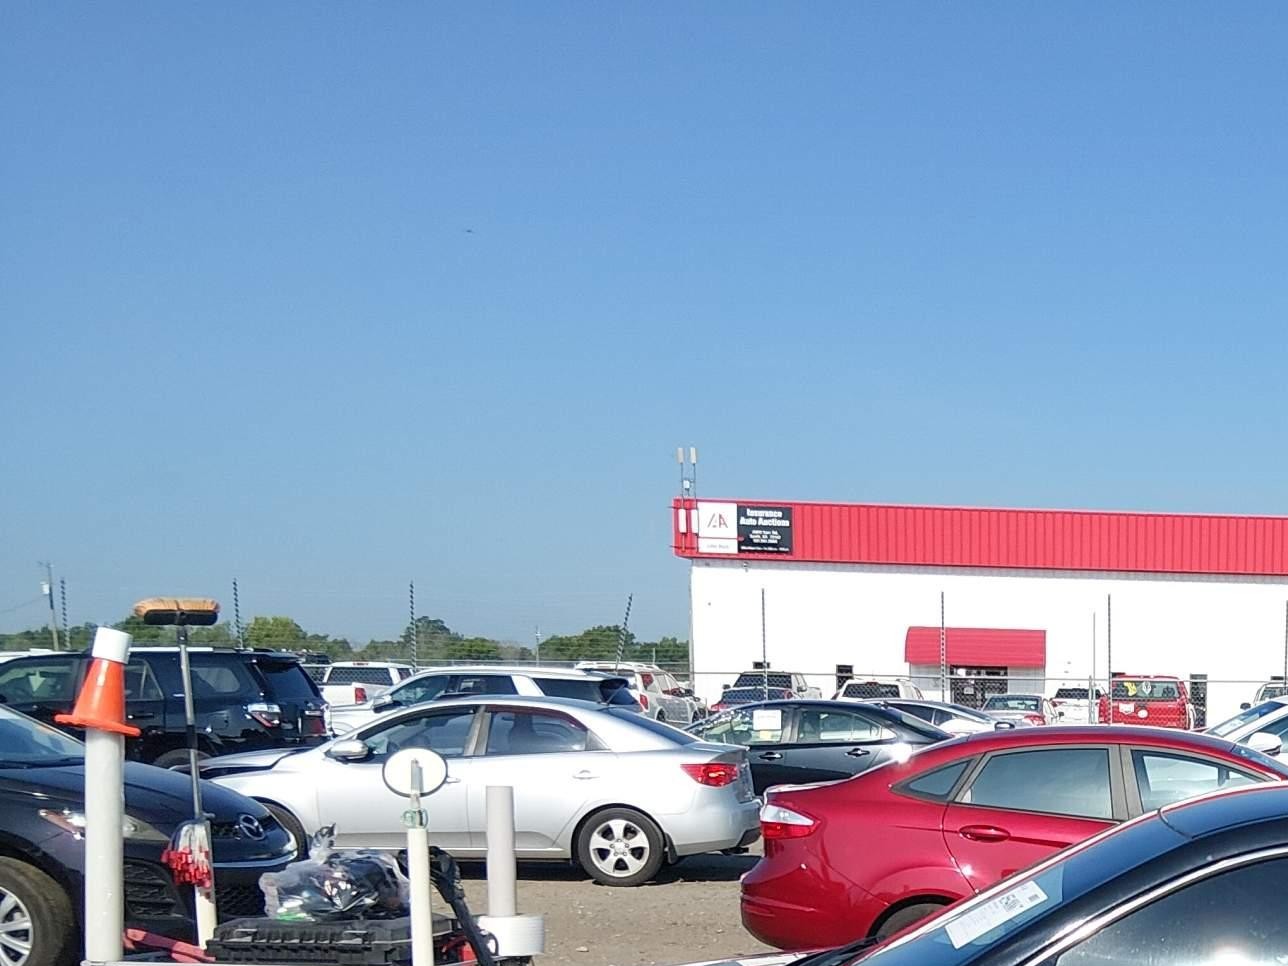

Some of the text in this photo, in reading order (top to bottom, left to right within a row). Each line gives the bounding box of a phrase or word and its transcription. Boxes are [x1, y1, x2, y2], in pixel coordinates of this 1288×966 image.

[746, 508, 783, 518] Insurance
[740, 516, 790, 527] Auto Auctions
